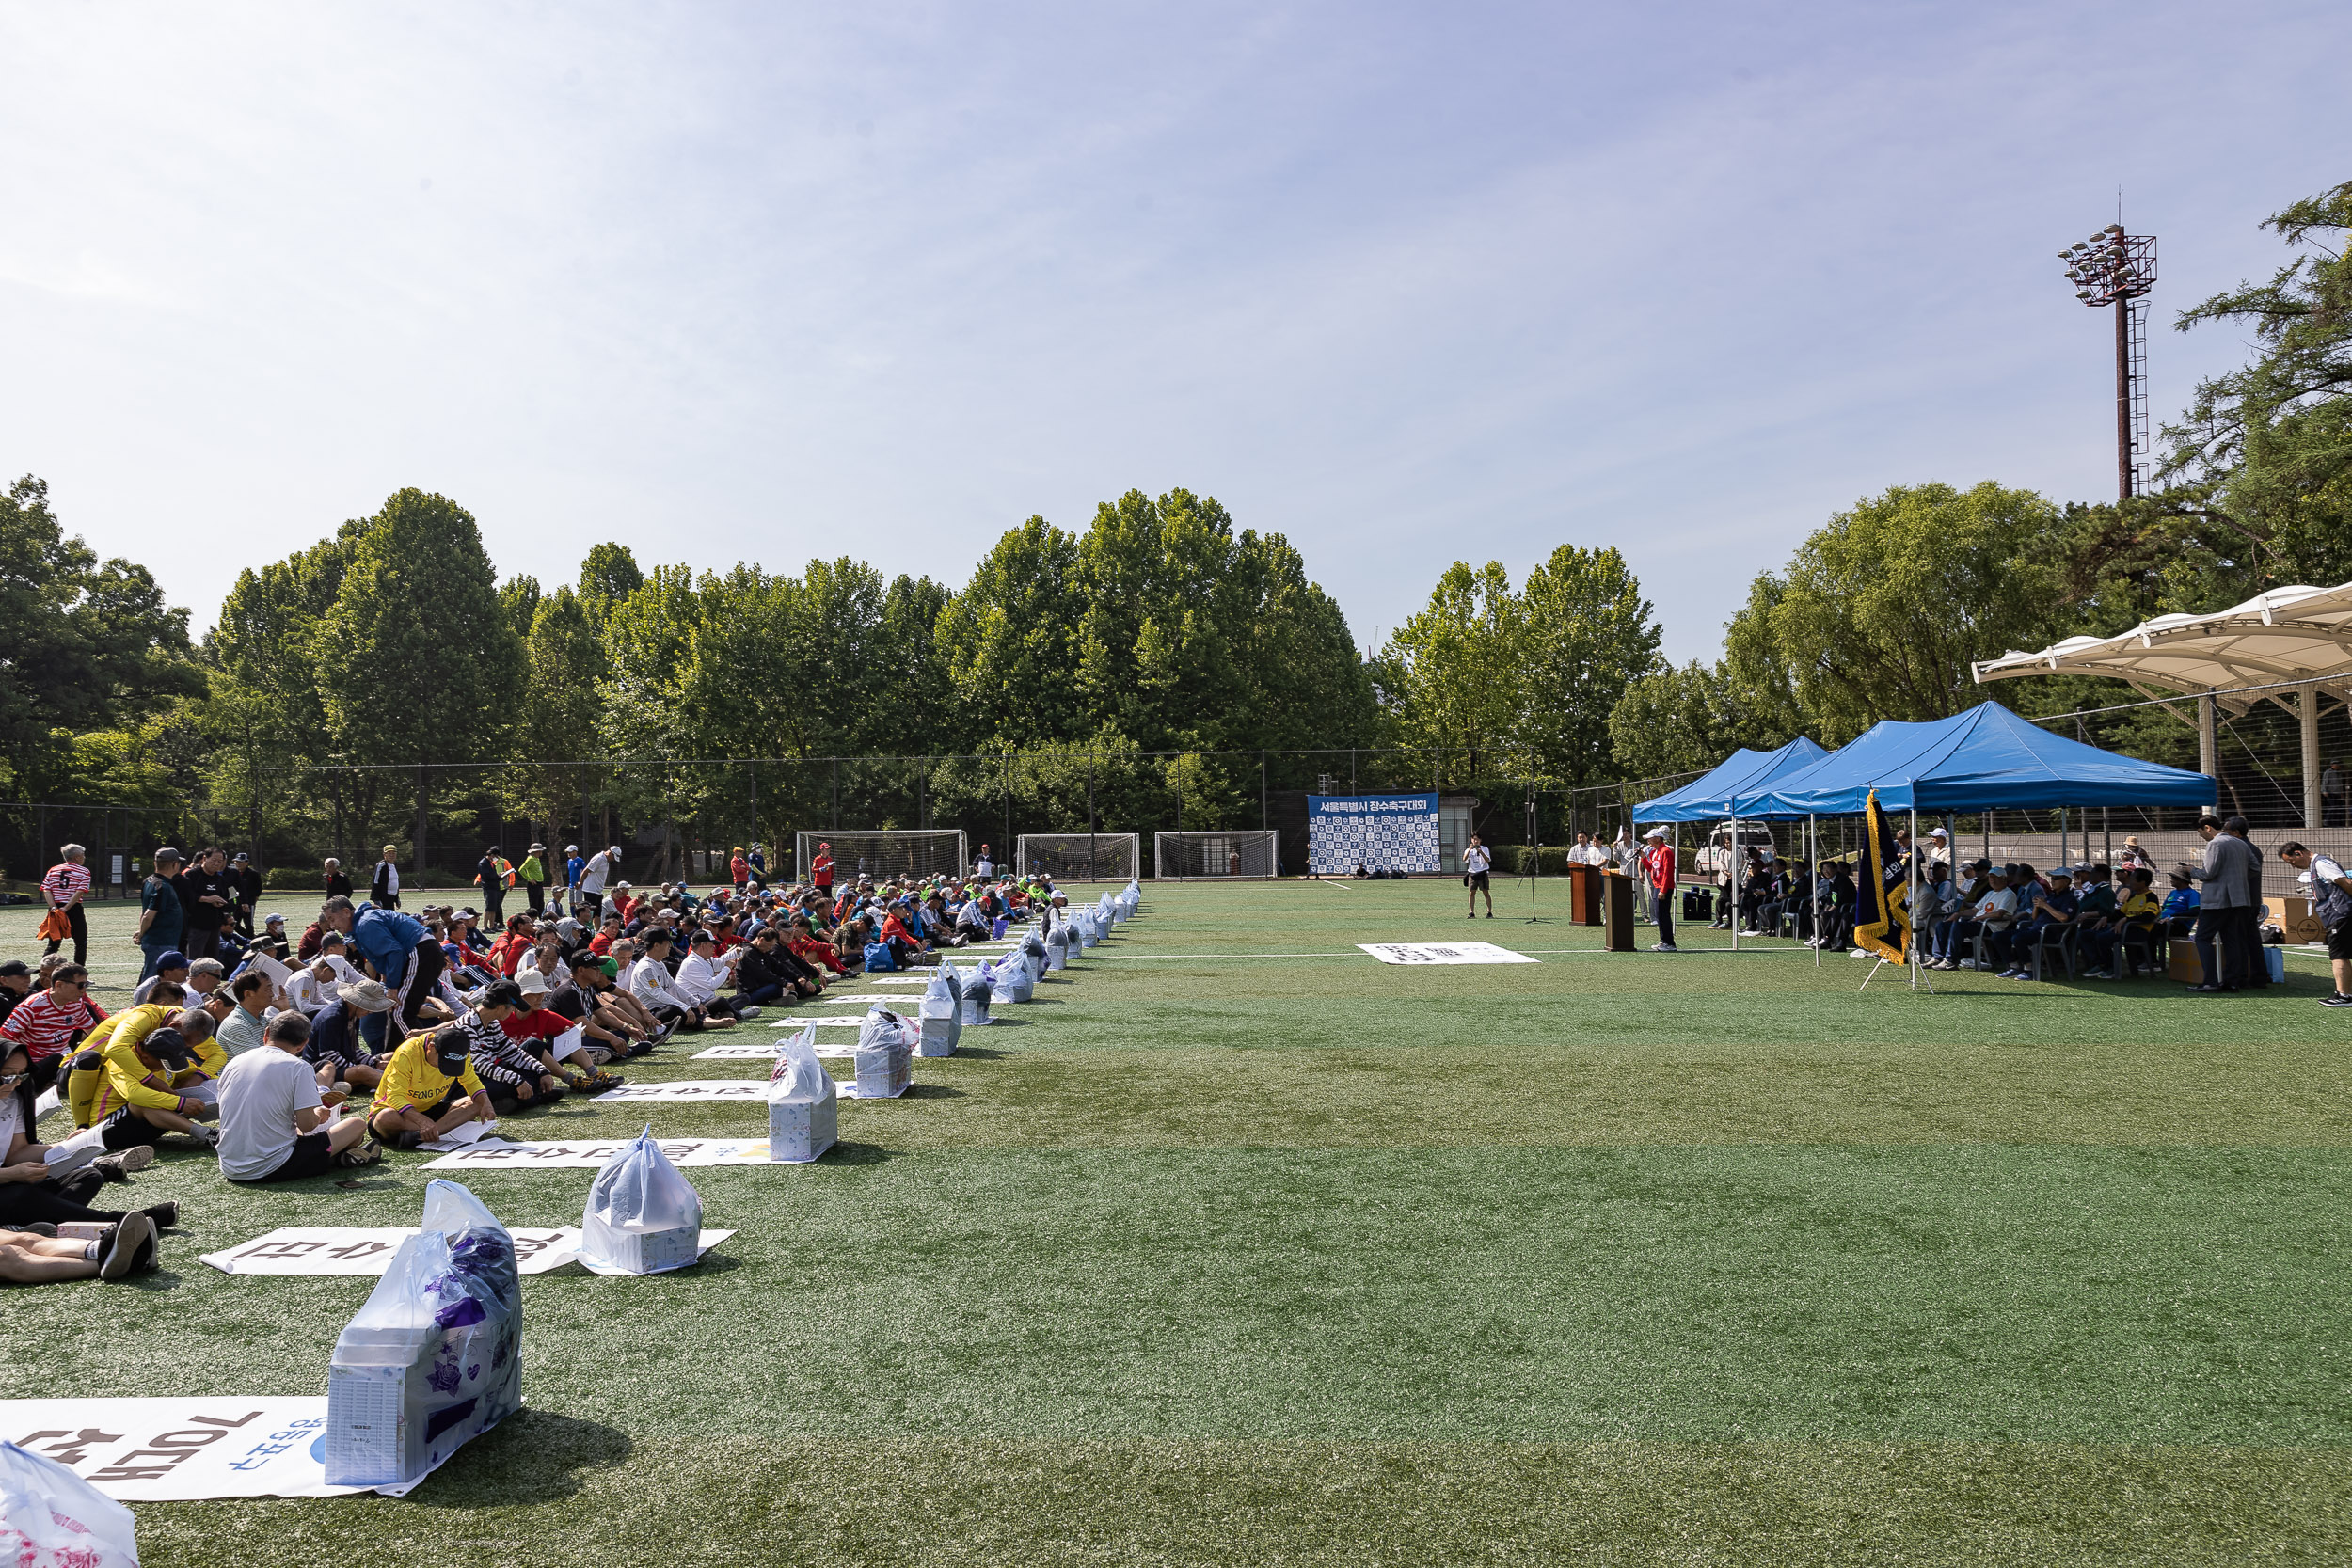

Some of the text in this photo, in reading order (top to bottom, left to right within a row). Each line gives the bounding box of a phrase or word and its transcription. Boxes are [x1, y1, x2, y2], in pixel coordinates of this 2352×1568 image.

[1320, 800, 1427, 813] 서울특별시 장수축구대회
[407, 1089, 434, 1100] SEONG
[85, 1411, 265, 1481] 70대
